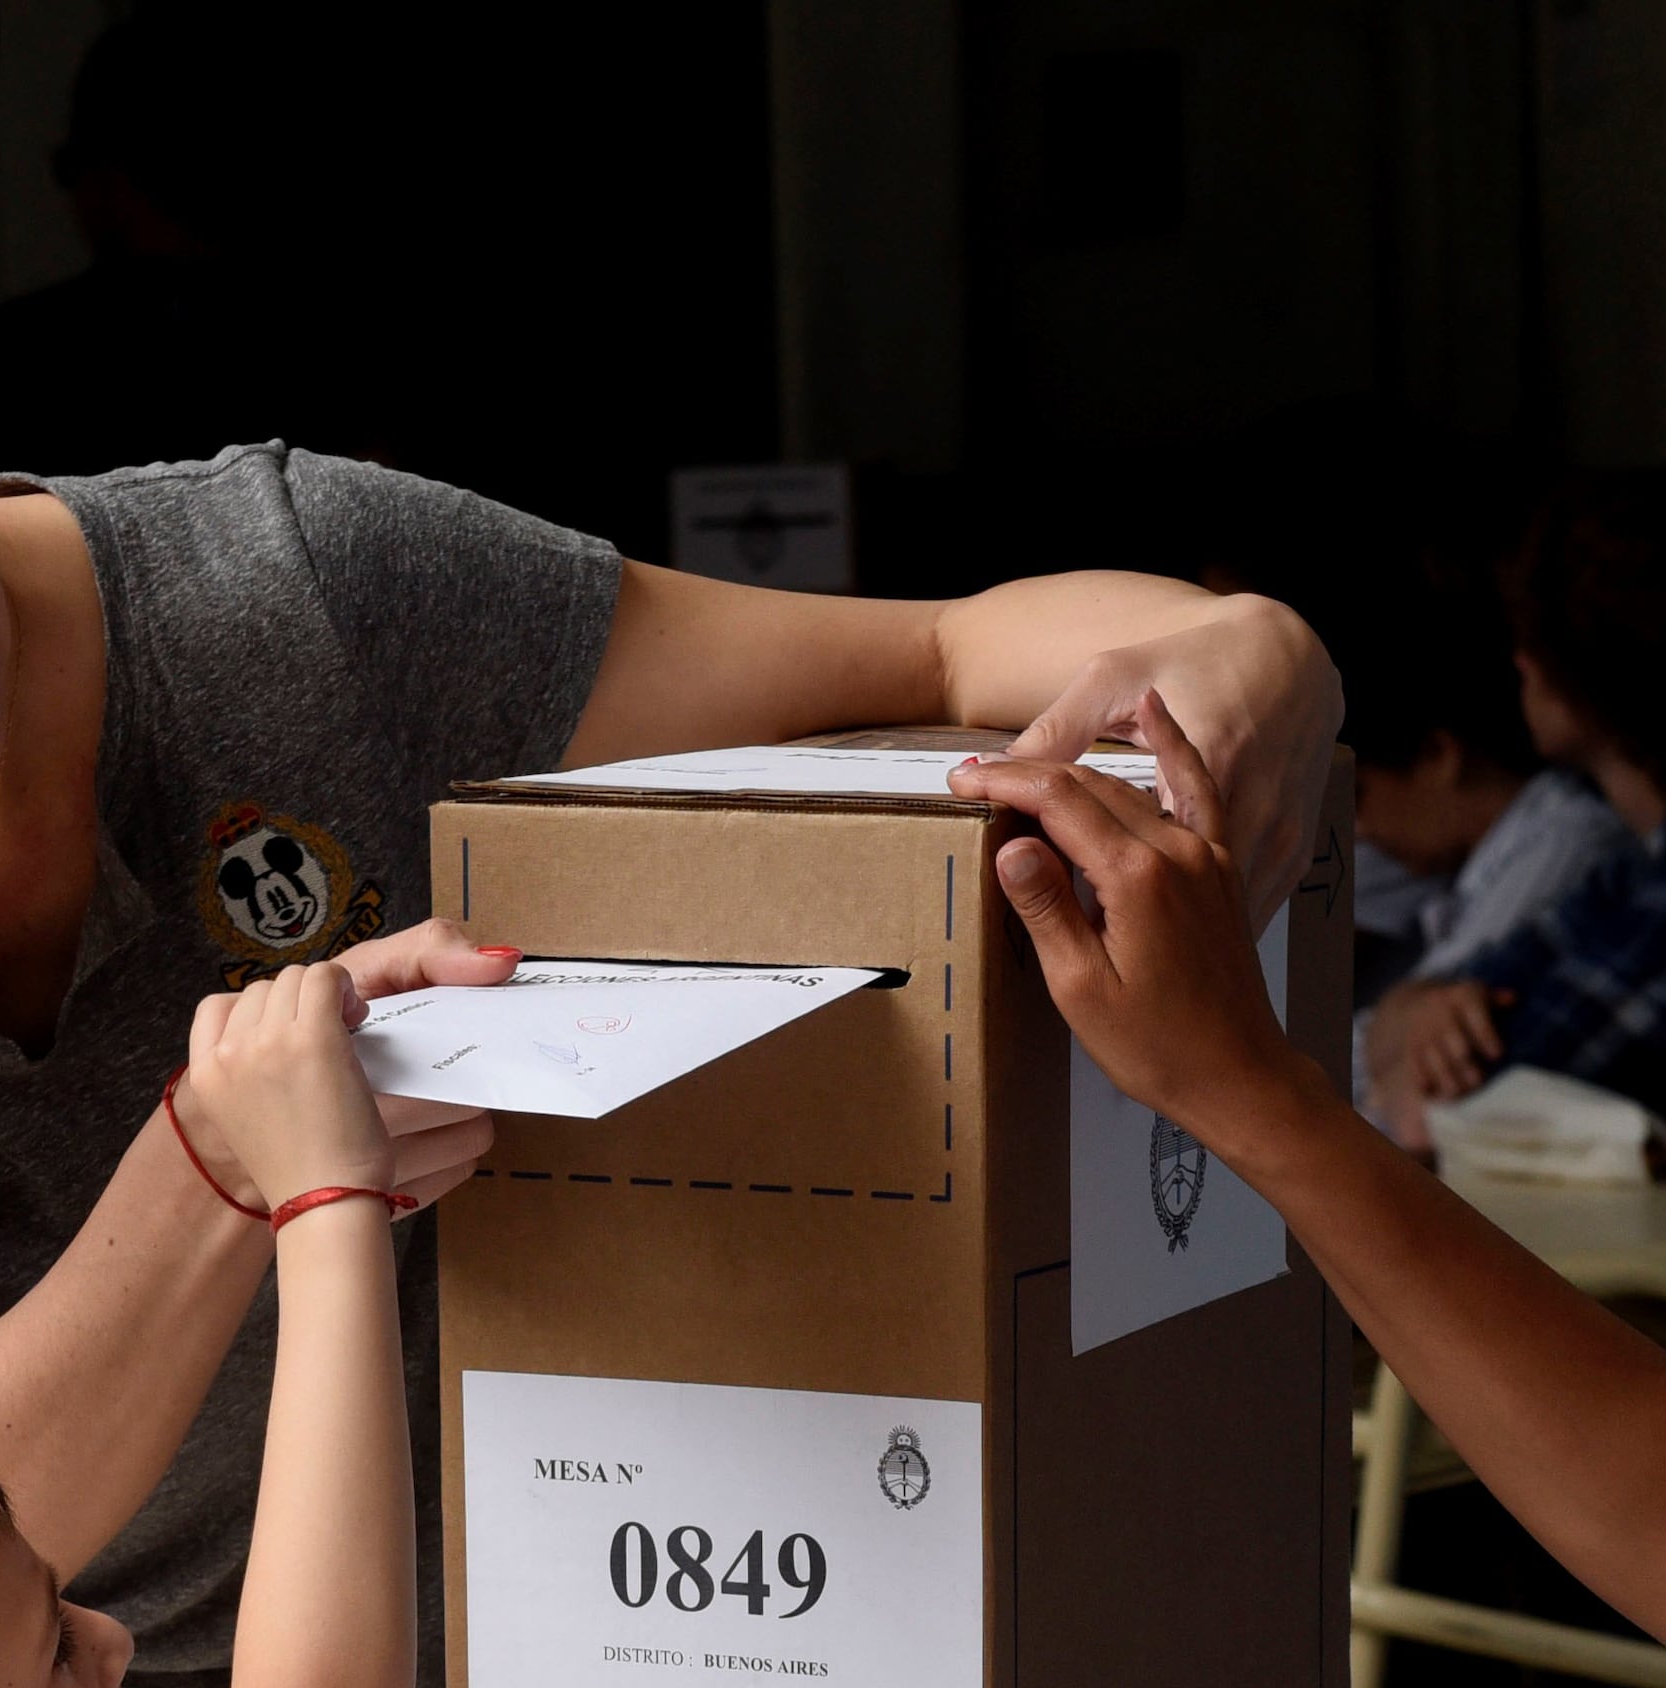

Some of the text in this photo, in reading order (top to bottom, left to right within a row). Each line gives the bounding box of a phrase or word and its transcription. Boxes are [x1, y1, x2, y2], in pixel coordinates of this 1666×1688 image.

[534, 1458, 608, 1484] MESA
[609, 1521, 828, 1619] 0849
[603, 1645, 684, 1667] DISTRITO
[704, 1653, 774, 1674] BUENOS
[777, 1657, 830, 1678] AIRES
